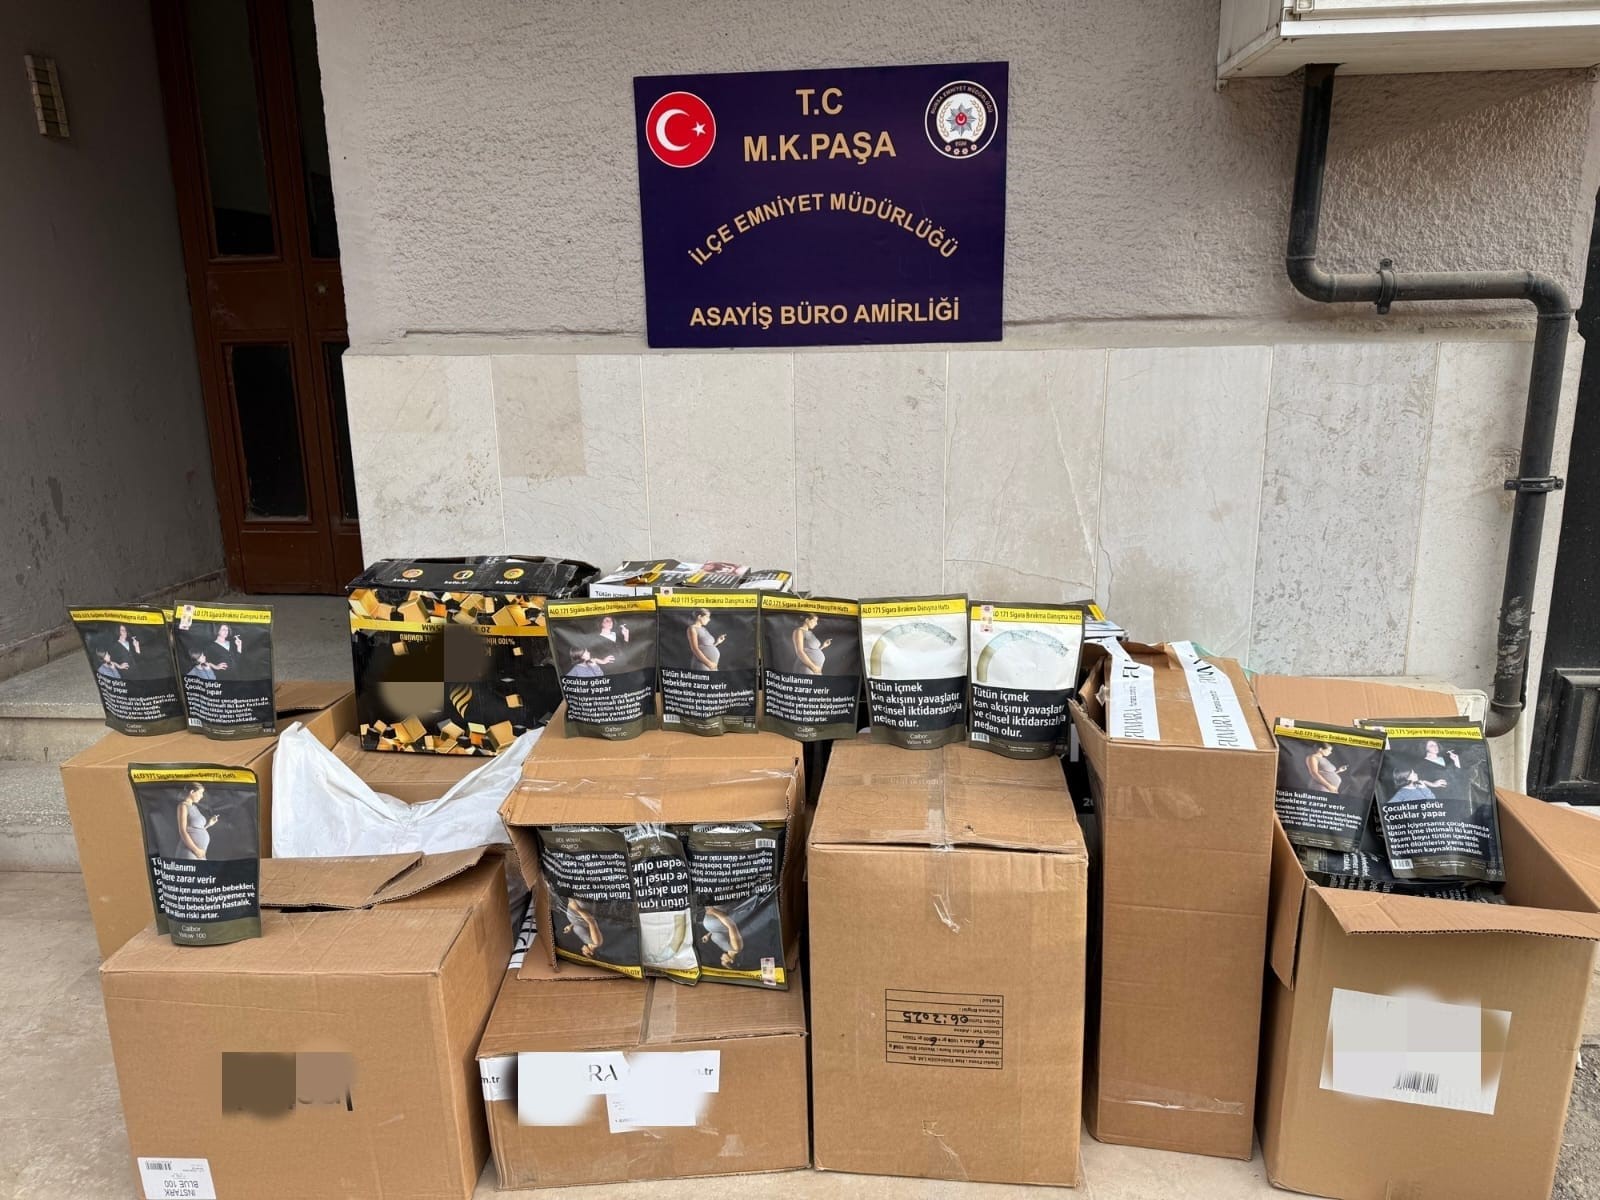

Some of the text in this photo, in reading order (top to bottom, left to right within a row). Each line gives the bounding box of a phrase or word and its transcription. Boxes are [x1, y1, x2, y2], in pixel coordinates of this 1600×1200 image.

[796, 88, 844, 116] T.C
[744, 132, 896, 165] M.K.PAŞA
[688, 192, 960, 267] İLÇE EMNİYET MÜDÜRLÜĞÜ
[689, 297, 959, 330] ASAYİŞ BÜRO AMİRLİĞİ
[662, 670, 709, 681] Tütün kullanımı
[781, 675, 813, 685] kullanımı
[591, 678, 611, 687] görür
[591, 686, 611, 694] yapar
[895, 682, 923, 695] içmek
[886, 694, 916, 707] akışını
[918, 693, 960, 706] yavaşlatır
[973, 687, 1030, 703] Tütün içmek
[908, 703, 962, 716] iktidarsızlığa
[973, 697, 988, 709] kan
[991, 702, 1021, 715] akışını
[899, 718, 919, 727] olur.
[986, 712, 1010, 725] cinsel
[974, 720, 1022, 738] neden olur.
[1294, 792, 1328, 802] kullanımı
[1383, 802, 1444, 814] Çocuklar görür
[1384, 811, 1447, 823] Çocuklar yapar
[164, 861, 196, 872] kullanımı
[632, 862, 654, 874] olur.
[176, 875, 216, 884] zarar verir
[646, 873, 674, 886] cinsel
[677, 872, 688, 880] ve
[180, 883, 255, 894] içen annelerin bebekleri,
[671, 884, 688, 894] kan
[695, 886, 713, 894] verir
[178, 895, 205, 903] yeterince
[206, 892, 246, 903] büyüyemez
[609, 891, 631, 900] Tütün
[714, 891, 750, 902] kullanımı
[222, 899, 252, 909] hastalık,
[661, 896, 690, 909] Tütün
[164, 1180, 199, 1188] BLUE 100
[164, 1189, 196, 1197] INSTARK
